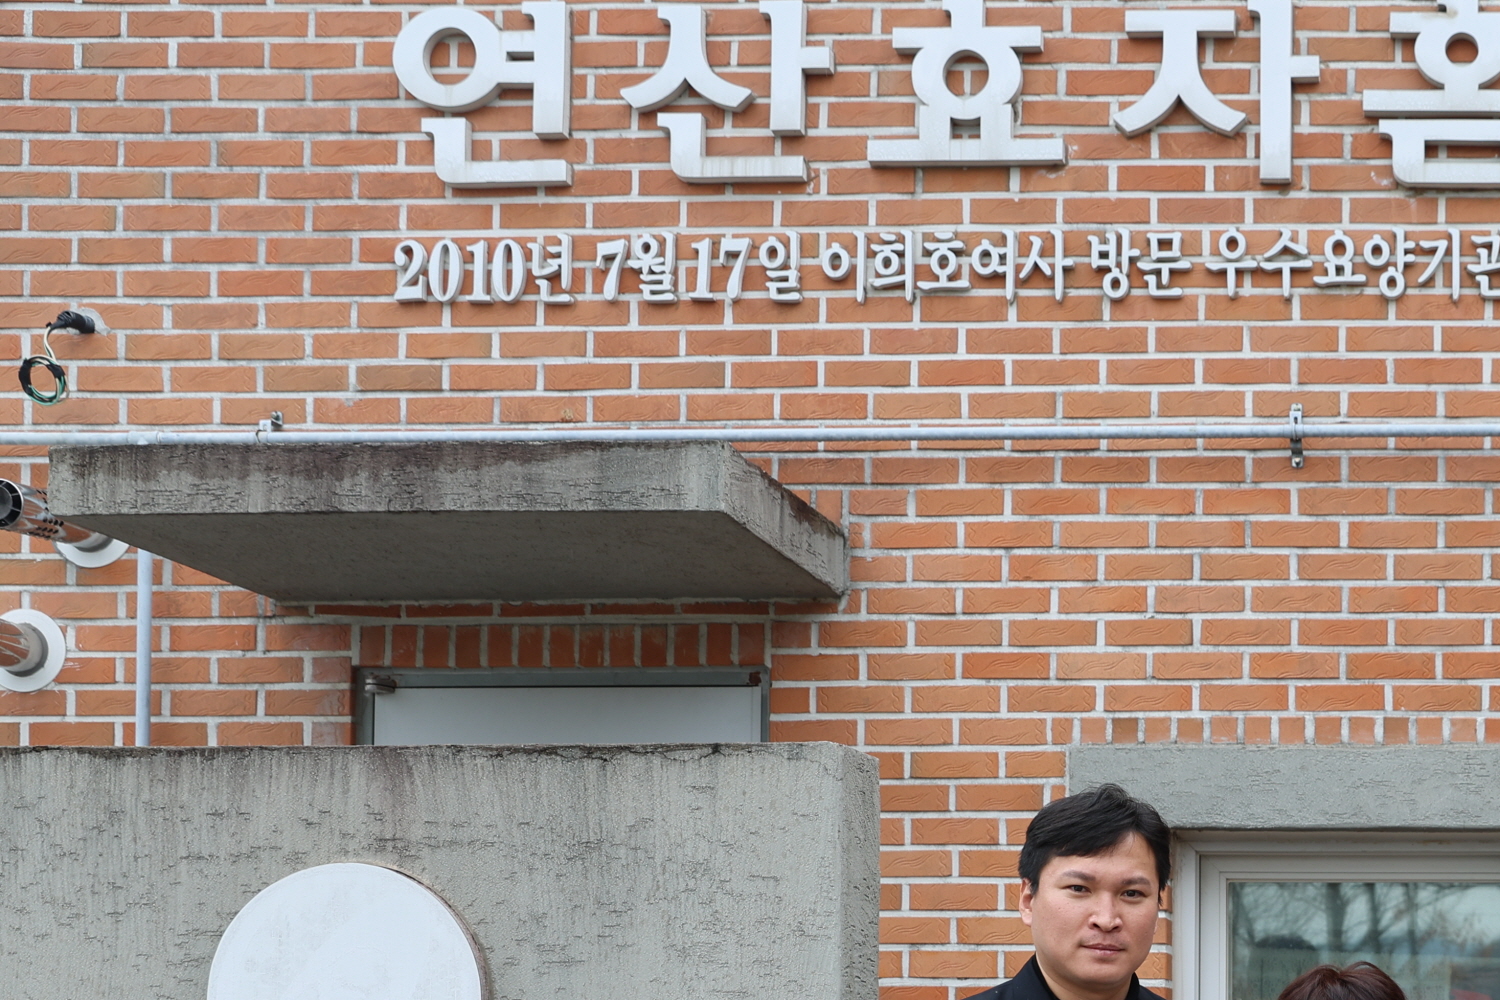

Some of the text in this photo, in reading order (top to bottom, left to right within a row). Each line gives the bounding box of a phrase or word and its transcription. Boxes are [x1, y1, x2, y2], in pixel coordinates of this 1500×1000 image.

[394, 233, 574, 304] 2010년
[595, 230, 678, 303] 7월
[688, 230, 802, 303] 17일
[820, 229, 1074, 304] 이희호여사
[1087, 228, 1193, 300] 방문
